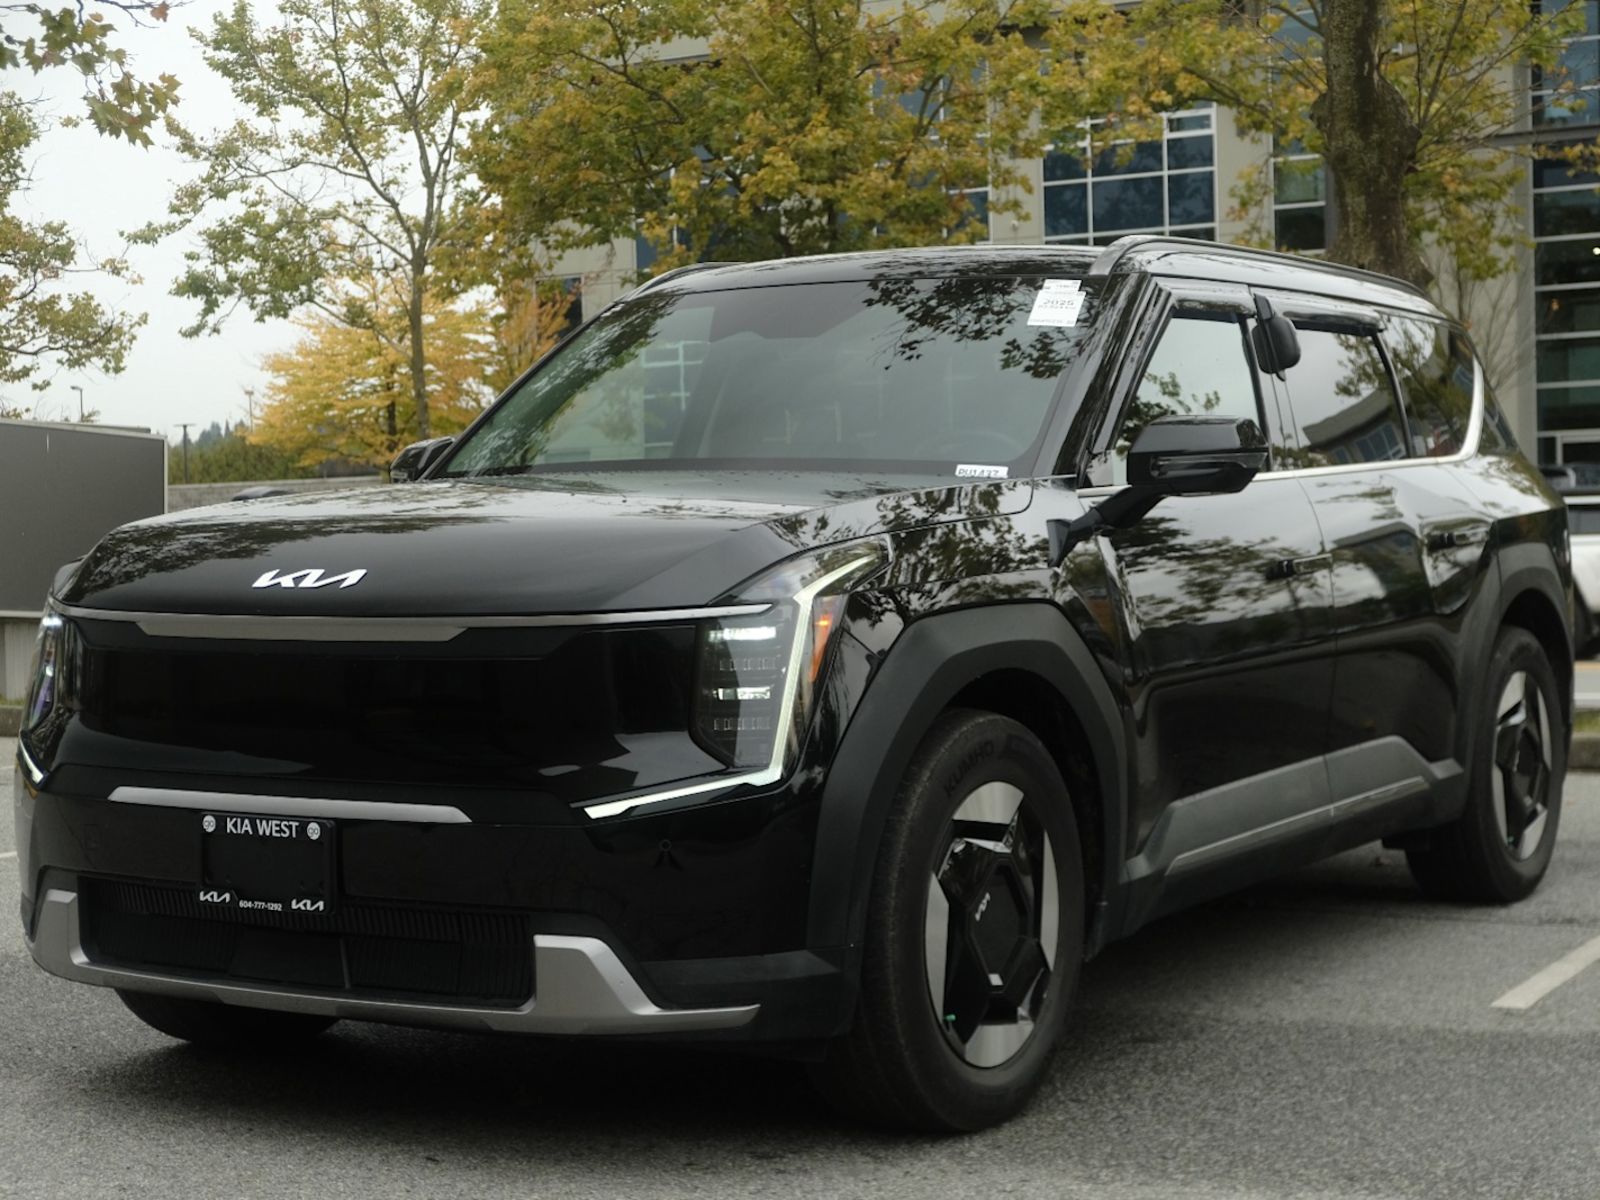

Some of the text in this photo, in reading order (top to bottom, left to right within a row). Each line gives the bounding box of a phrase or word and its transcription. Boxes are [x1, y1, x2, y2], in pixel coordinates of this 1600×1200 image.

[251, 568, 368, 589] KIA
[944, 739, 995, 797] KUMHO
[226, 817, 300, 838] KIA WEST
[199, 890, 231, 903] KIA
[291, 898, 324, 912] KIA
[239, 899, 283, 912] 604-777-1292
